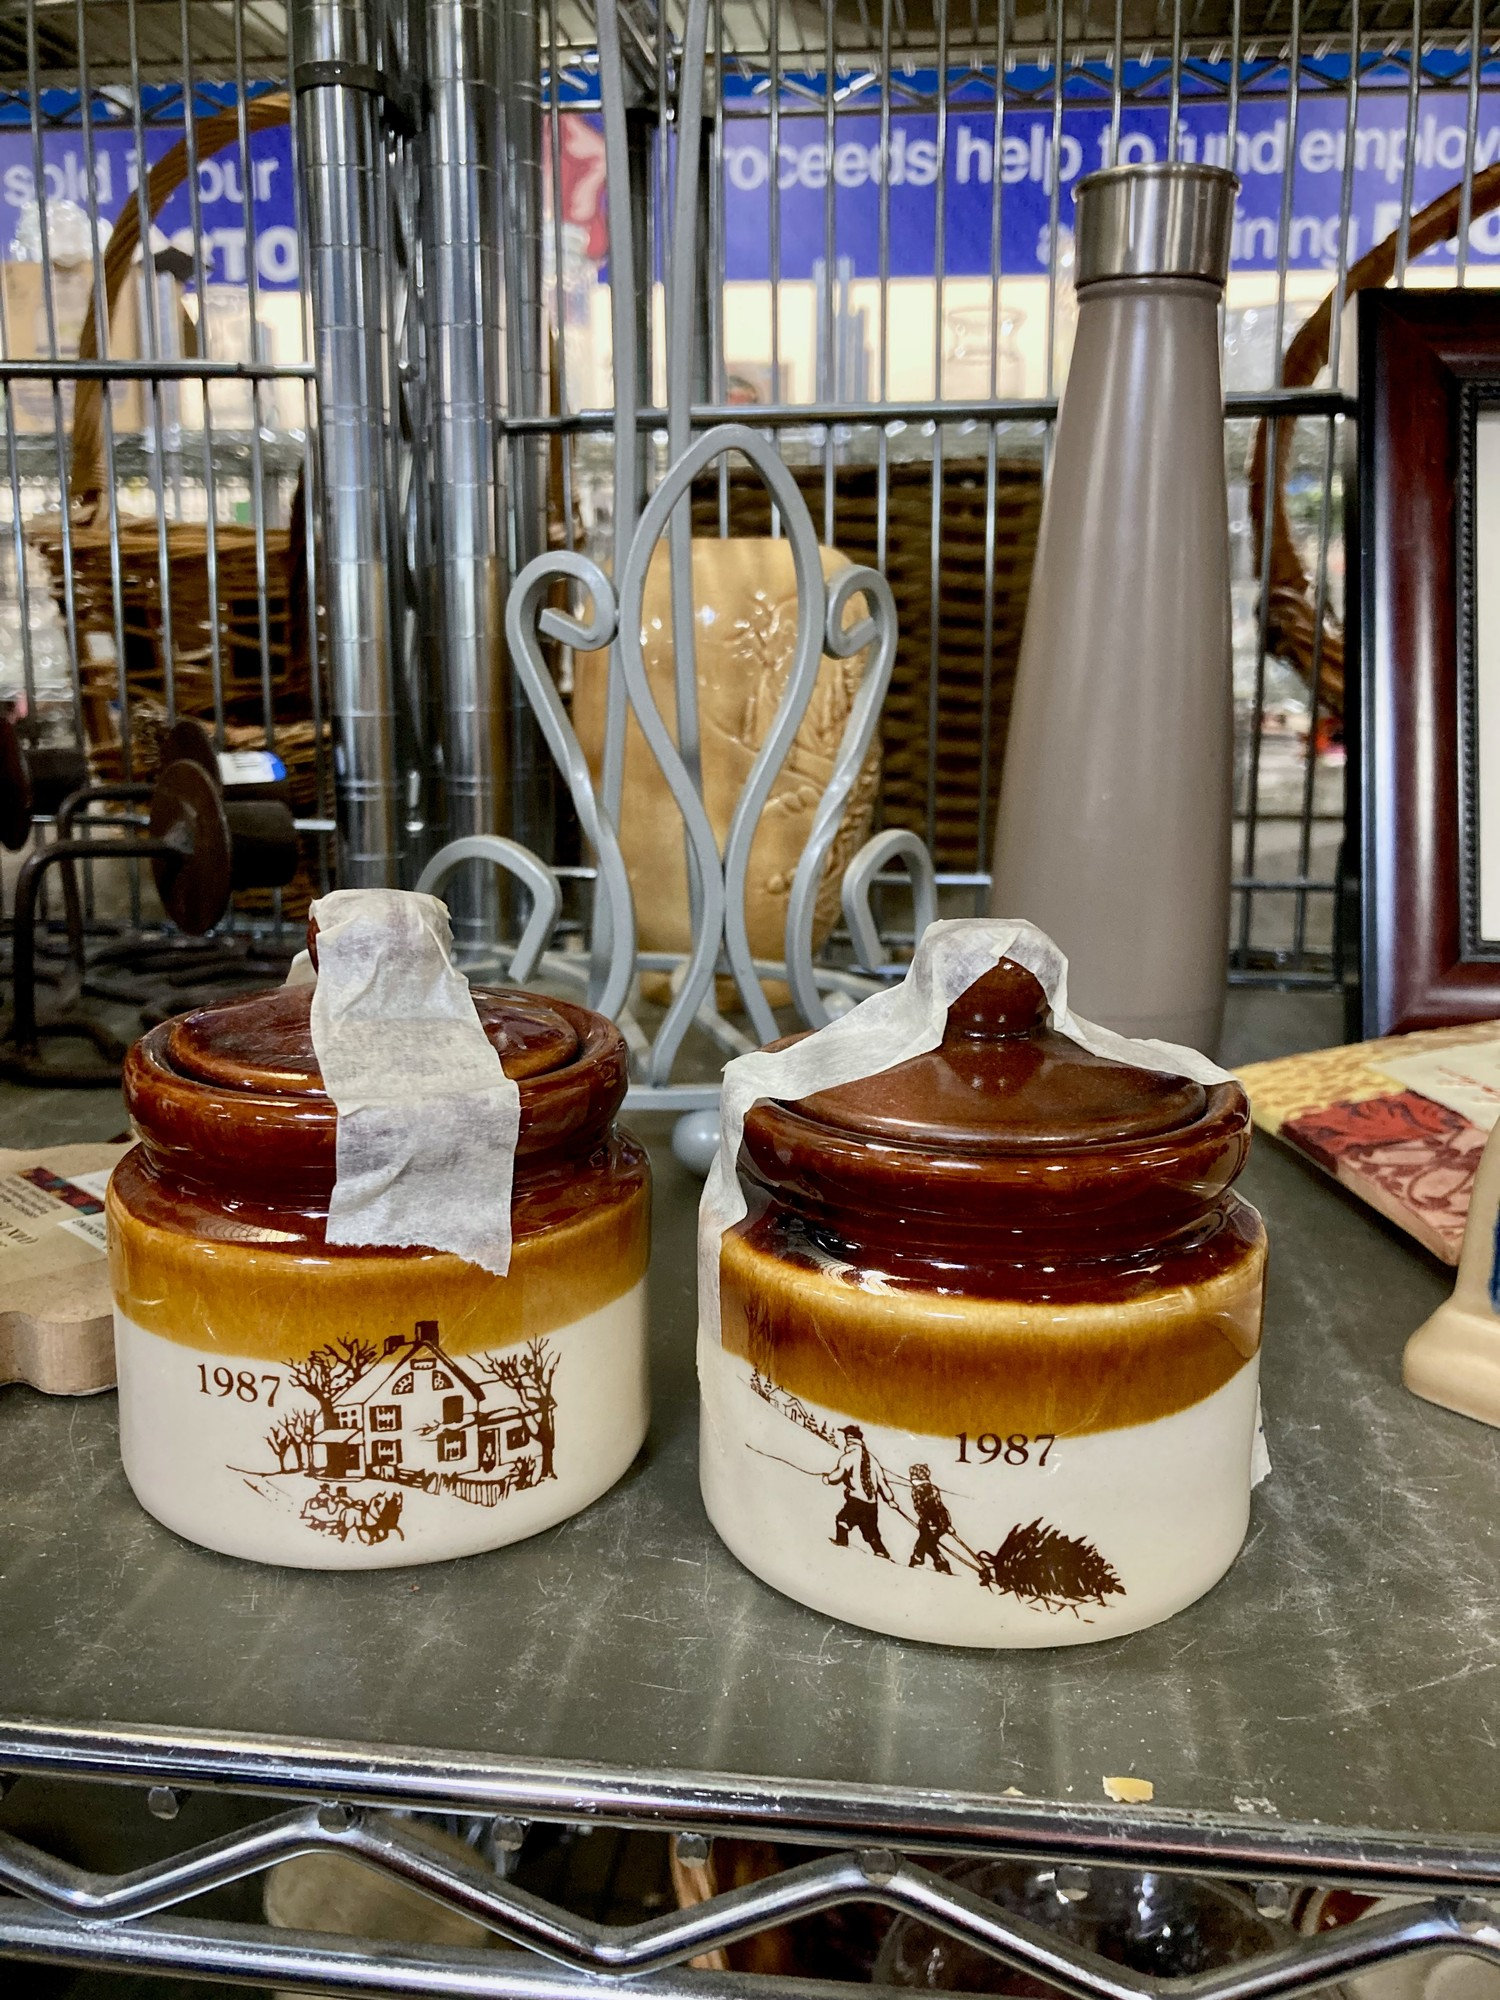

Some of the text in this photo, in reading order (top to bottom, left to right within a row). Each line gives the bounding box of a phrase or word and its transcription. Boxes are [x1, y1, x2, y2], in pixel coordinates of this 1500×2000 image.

[3, 150, 279, 207] sold i our
[955, 123, 1083, 196] help
[1098, 122, 1157, 170] to
[197, 1363, 281, 1408] 1987
[955, 1431, 1056, 1467] 1987
